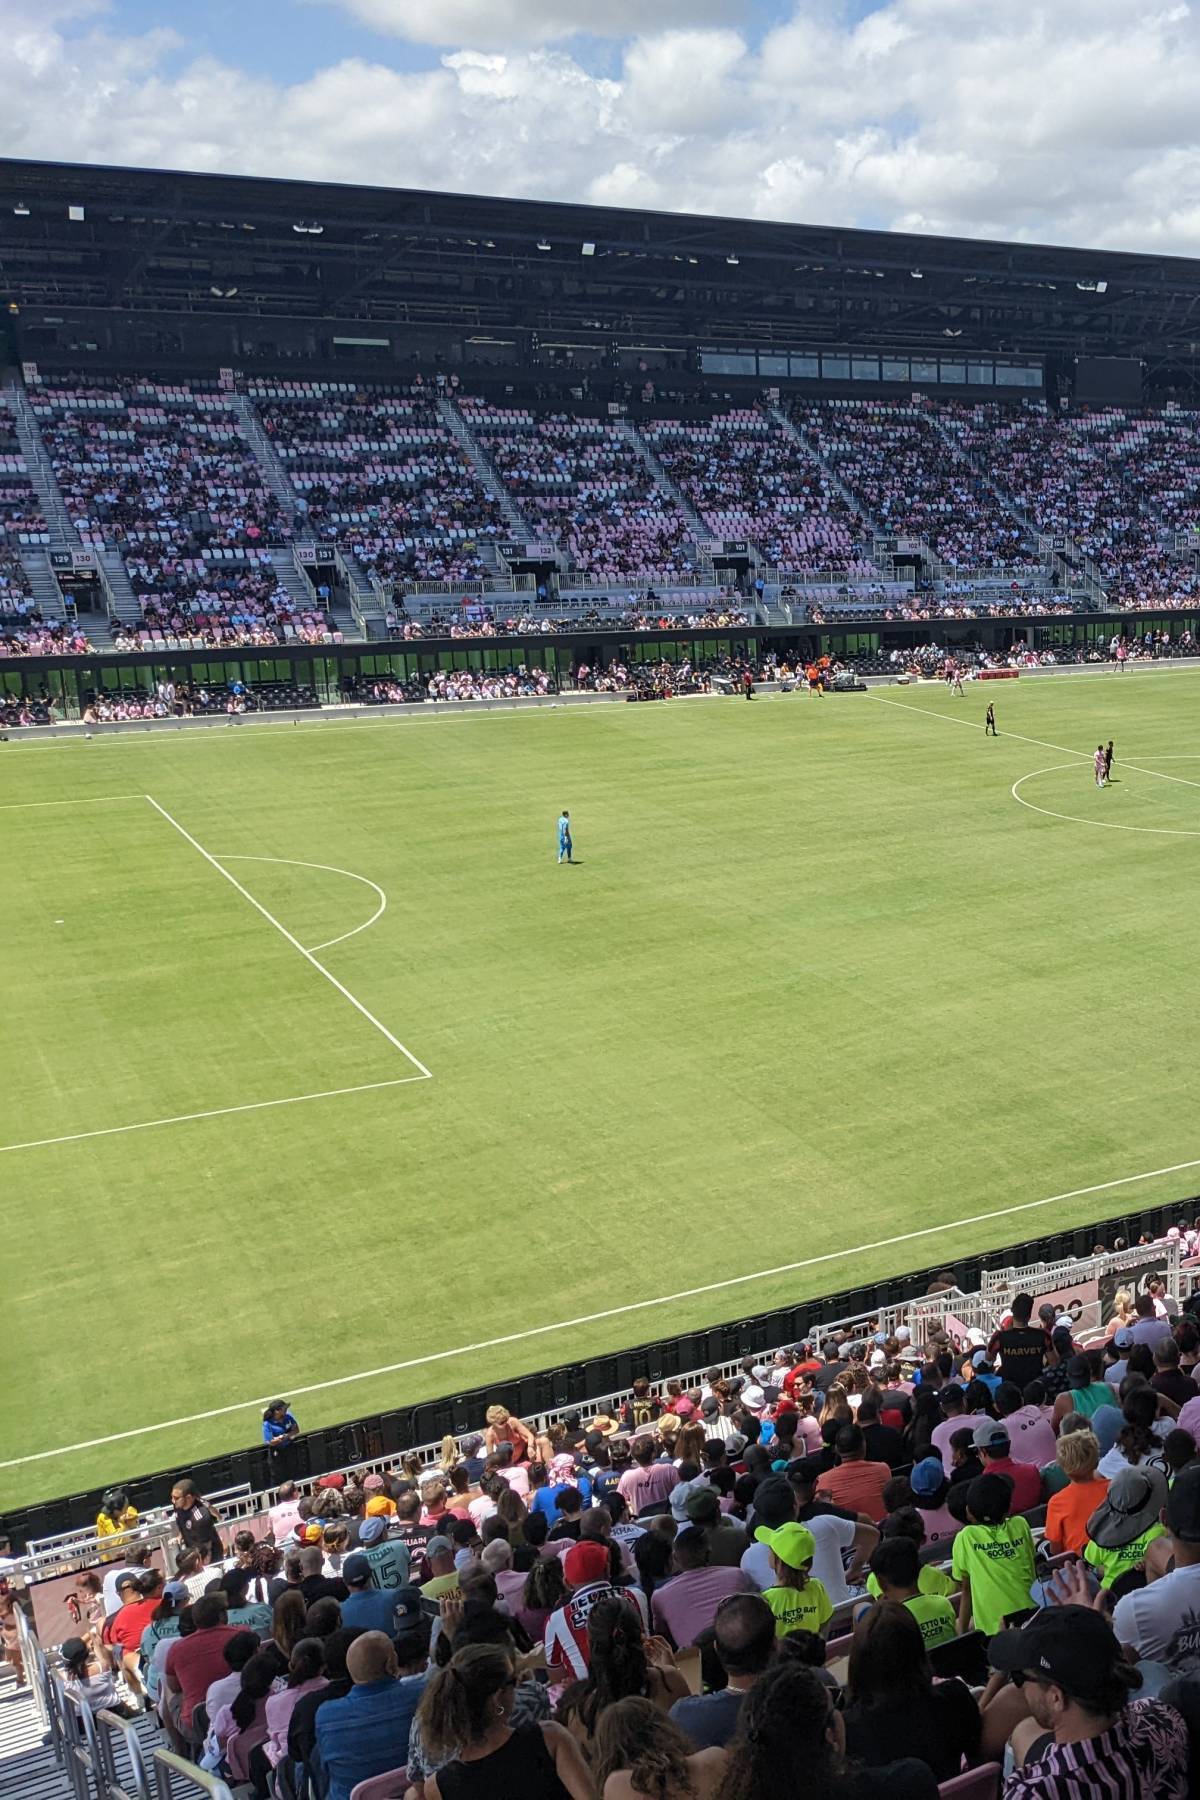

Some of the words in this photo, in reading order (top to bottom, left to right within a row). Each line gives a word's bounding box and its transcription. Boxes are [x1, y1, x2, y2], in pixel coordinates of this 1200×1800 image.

[318, 550, 332, 558] 131
[54, 555, 69, 563] 129
[75, 555, 91, 563] 130
[1003, 1347, 1042, 1355] HARVEY
[633, 1409, 651, 1427] 10
[973, 1542, 1011, 1552] PALMETTO
[1011, 1537, 1024, 1546] BAY
[987, 1549, 1016, 1559] SOCCER
[372, 1560, 402, 1590] 15
[803, 1606, 817, 1614] BAY
